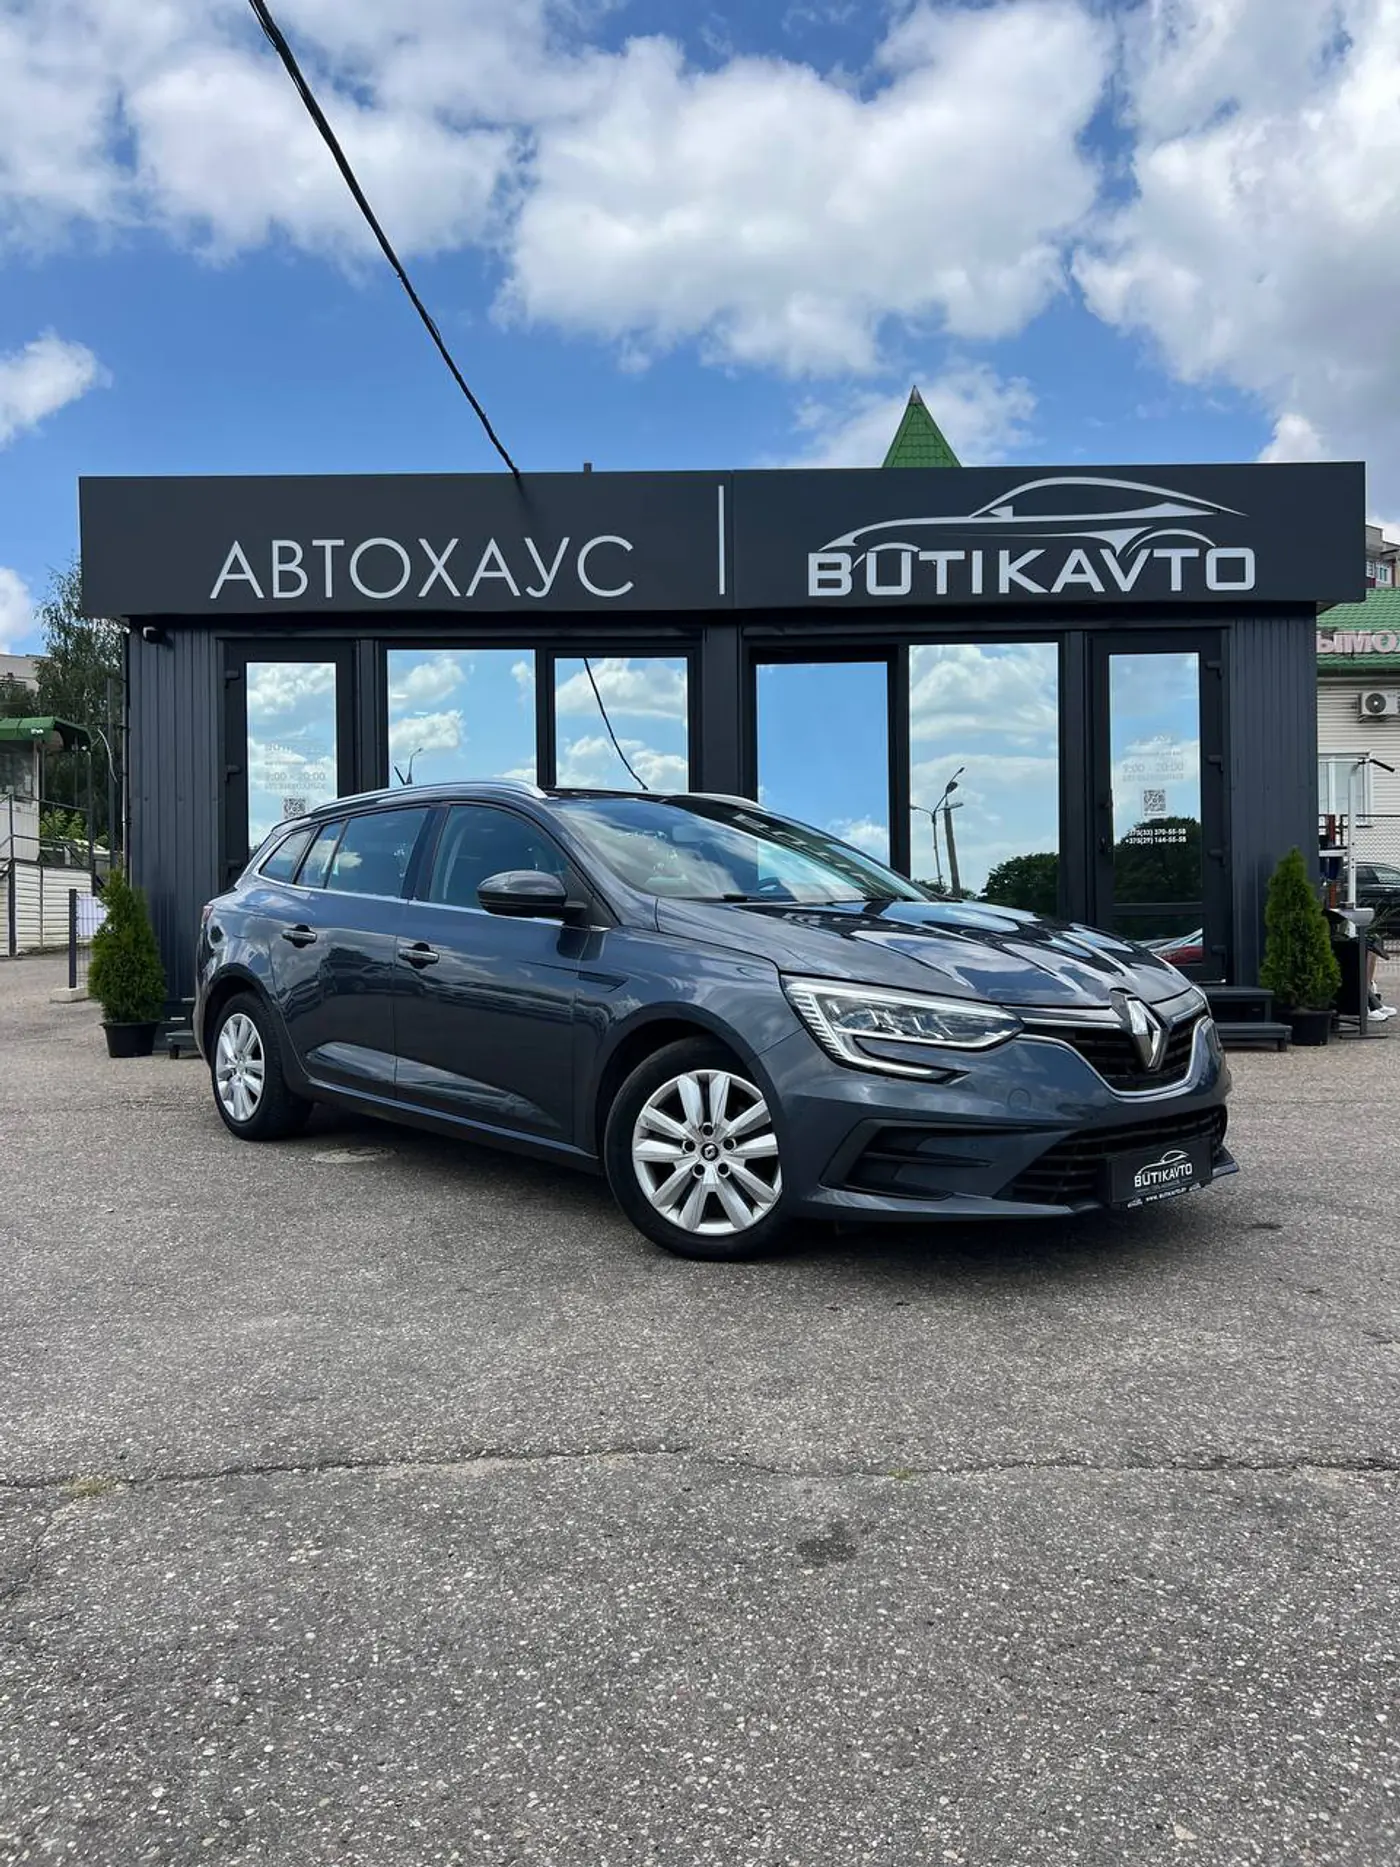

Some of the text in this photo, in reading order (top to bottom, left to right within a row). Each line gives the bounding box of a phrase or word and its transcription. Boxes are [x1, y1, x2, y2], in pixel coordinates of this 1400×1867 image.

[210, 535, 634, 599] АВТОХАУС
[808, 546, 1255, 597] BUTIKAVTO
[1316, 630, 1400, 653] ЫМО
[1134, 1163, 1193, 1187] BUTIKAVTO
